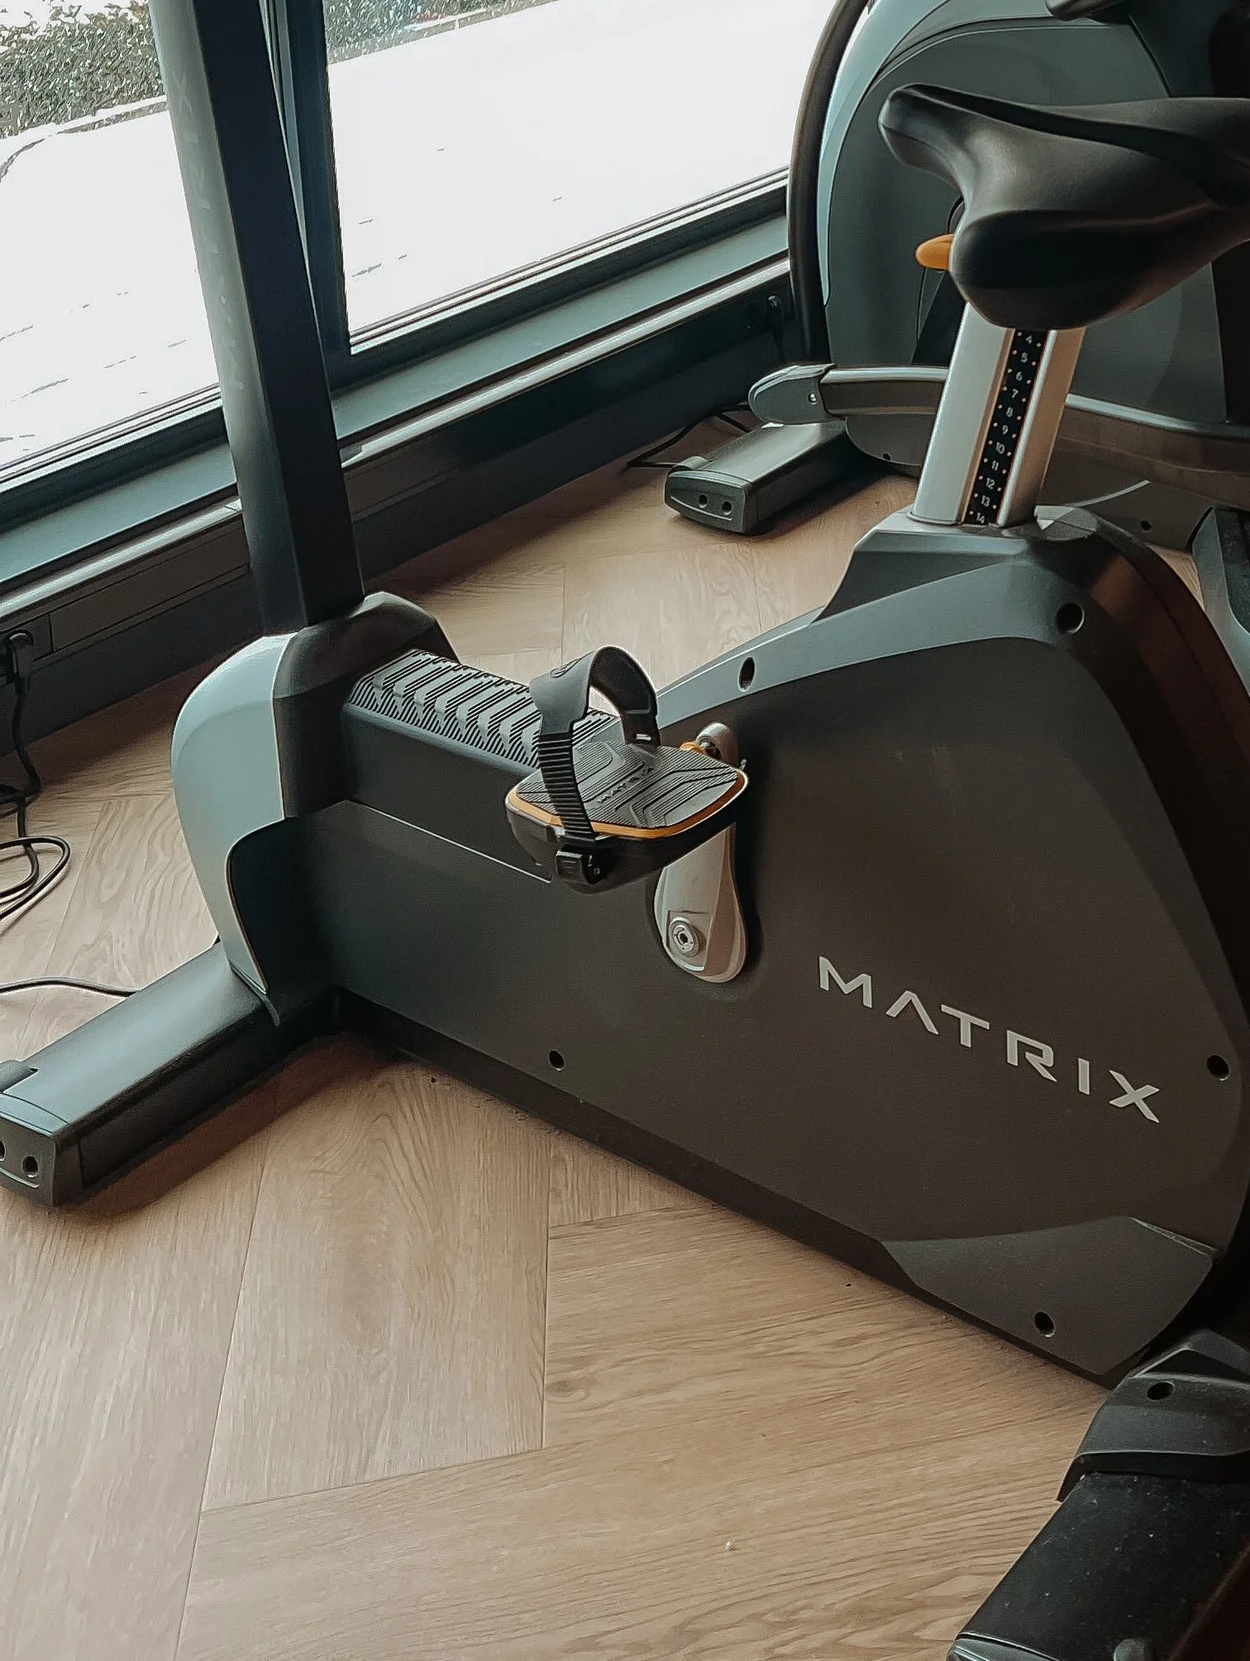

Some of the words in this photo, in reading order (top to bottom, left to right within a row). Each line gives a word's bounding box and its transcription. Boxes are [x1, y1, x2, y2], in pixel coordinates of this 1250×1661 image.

[1020, 352, 1028, 363] 5
[1015, 371, 1023, 382] 6
[1011, 388, 1019, 399] 7
[1006, 406, 1014, 418] 8
[1001, 424, 1009, 435] 9
[995, 441, 1005, 455] 10
[990, 459, 999, 472] 11
[985, 477, 996, 490] 12
[980, 494, 991, 507] 13
[976, 512, 986, 524] 14
[596, 766, 655, 804] MATRIX
[817, 955, 1161, 1124] MATRIX
